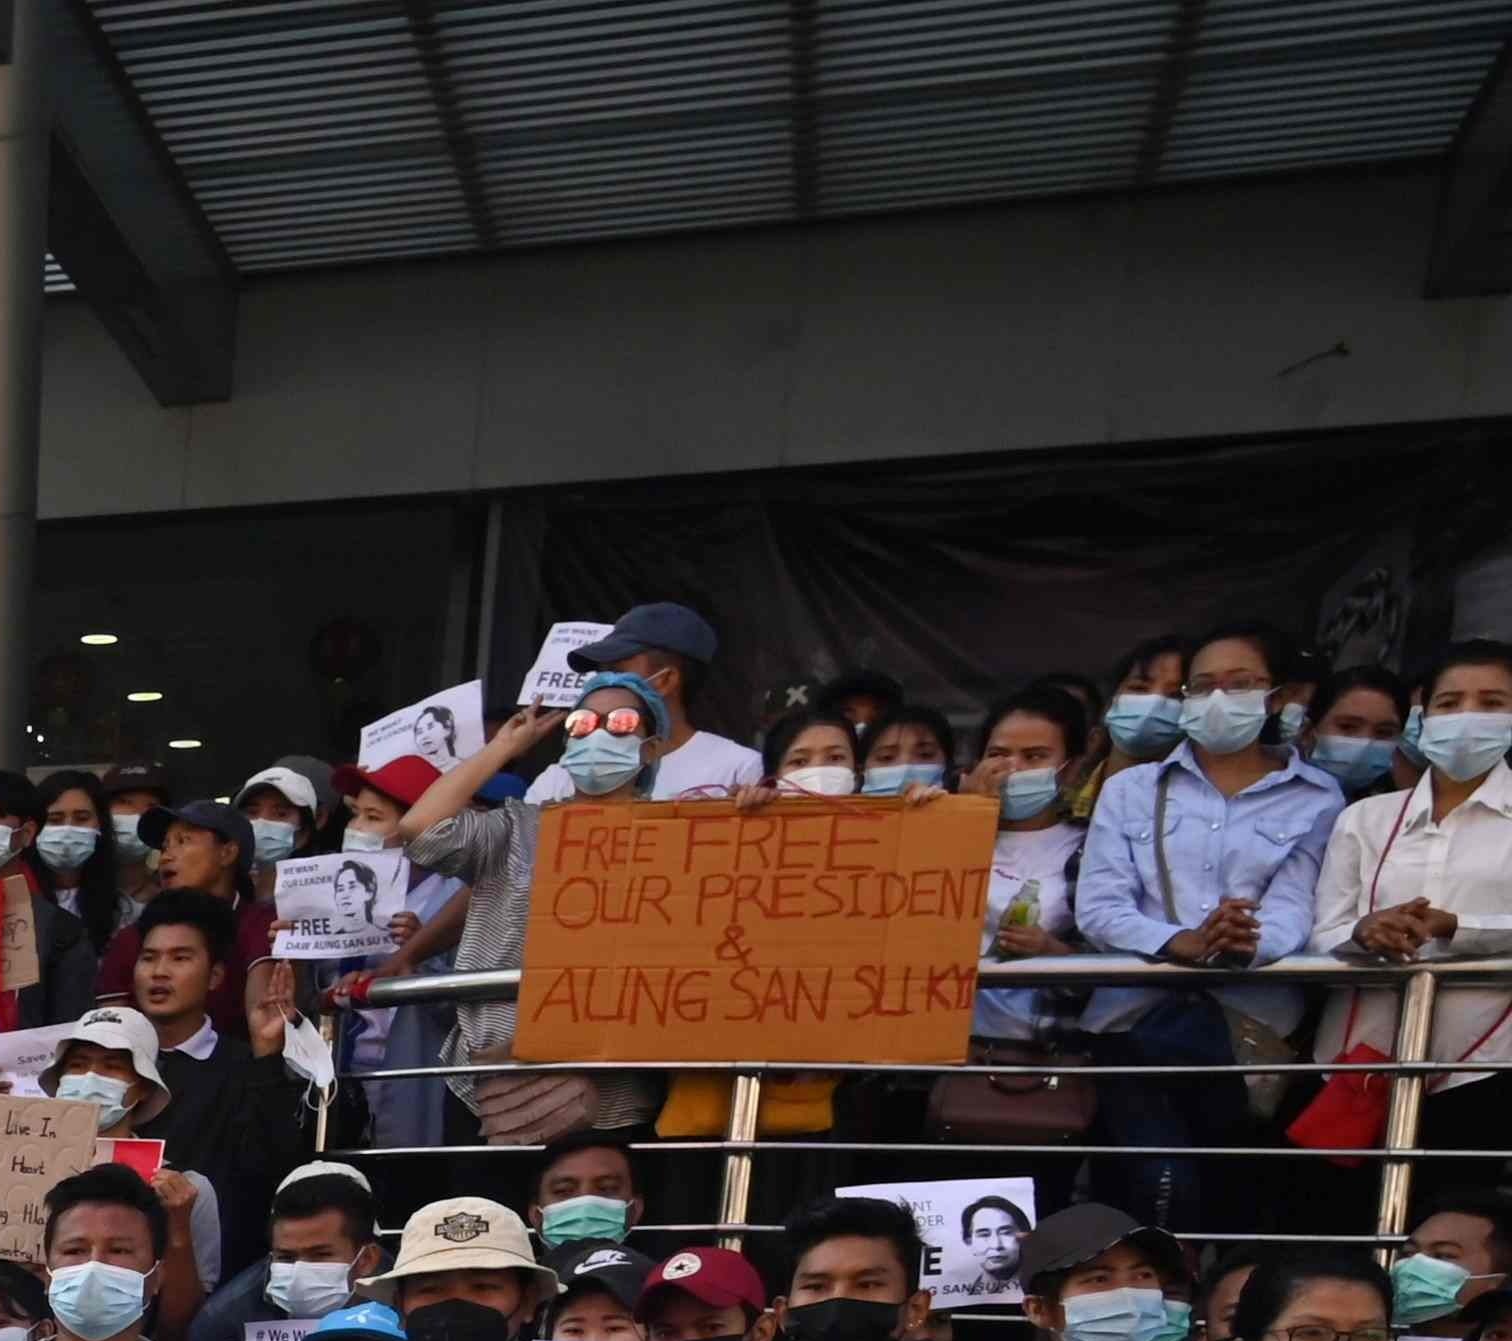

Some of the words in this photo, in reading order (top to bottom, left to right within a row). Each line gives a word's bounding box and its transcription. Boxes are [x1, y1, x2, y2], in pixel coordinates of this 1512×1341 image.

[536, 671, 584, 688] FREE
[554, 807, 659, 873] FREE
[684, 811, 885, 873] FREE
[553, 876, 672, 929] OUR
[695, 868, 990, 927] PRESIDENT
[289, 918, 332, 936] FREE
[715, 925, 753, 962] &
[532, 967, 711, 1028] AUNG
[723, 966, 832, 1024] SAN
[16, 1052, 45, 1065] Save
[5, 1110, 31, 1138] Live
[39, 1117, 56, 1139] In
[943, 1283, 971, 1295] SAN
